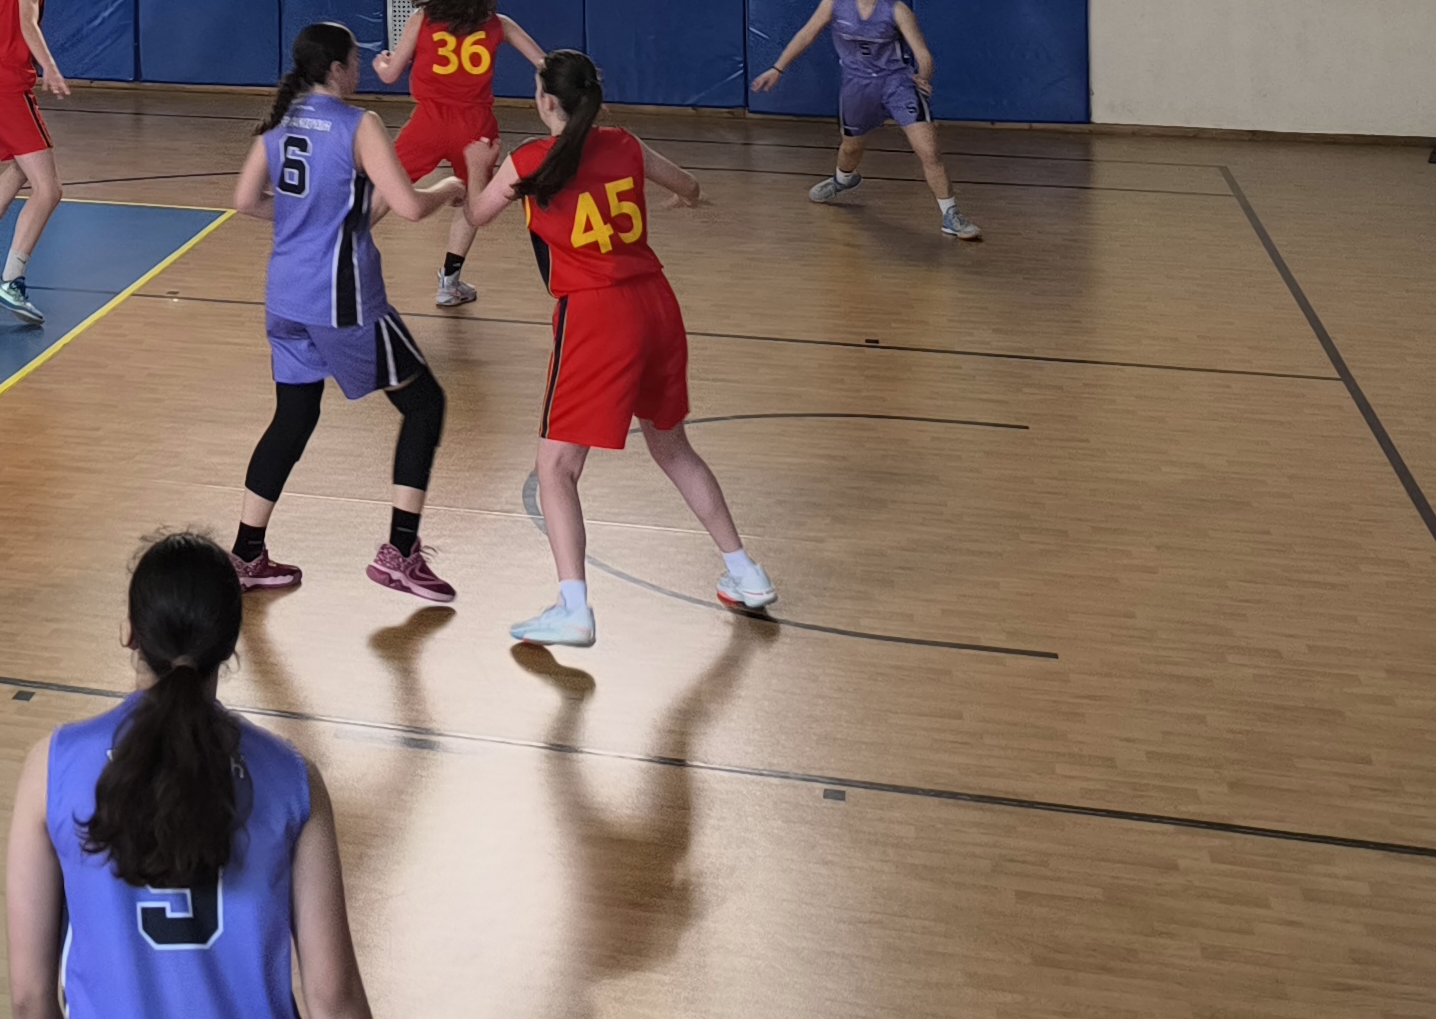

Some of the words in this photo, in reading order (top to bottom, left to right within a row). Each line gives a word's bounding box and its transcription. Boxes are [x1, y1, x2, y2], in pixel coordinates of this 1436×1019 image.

[431, 30, 491, 75] 36
[275, 133, 313, 198] 6
[569, 176, 644, 254] 45
